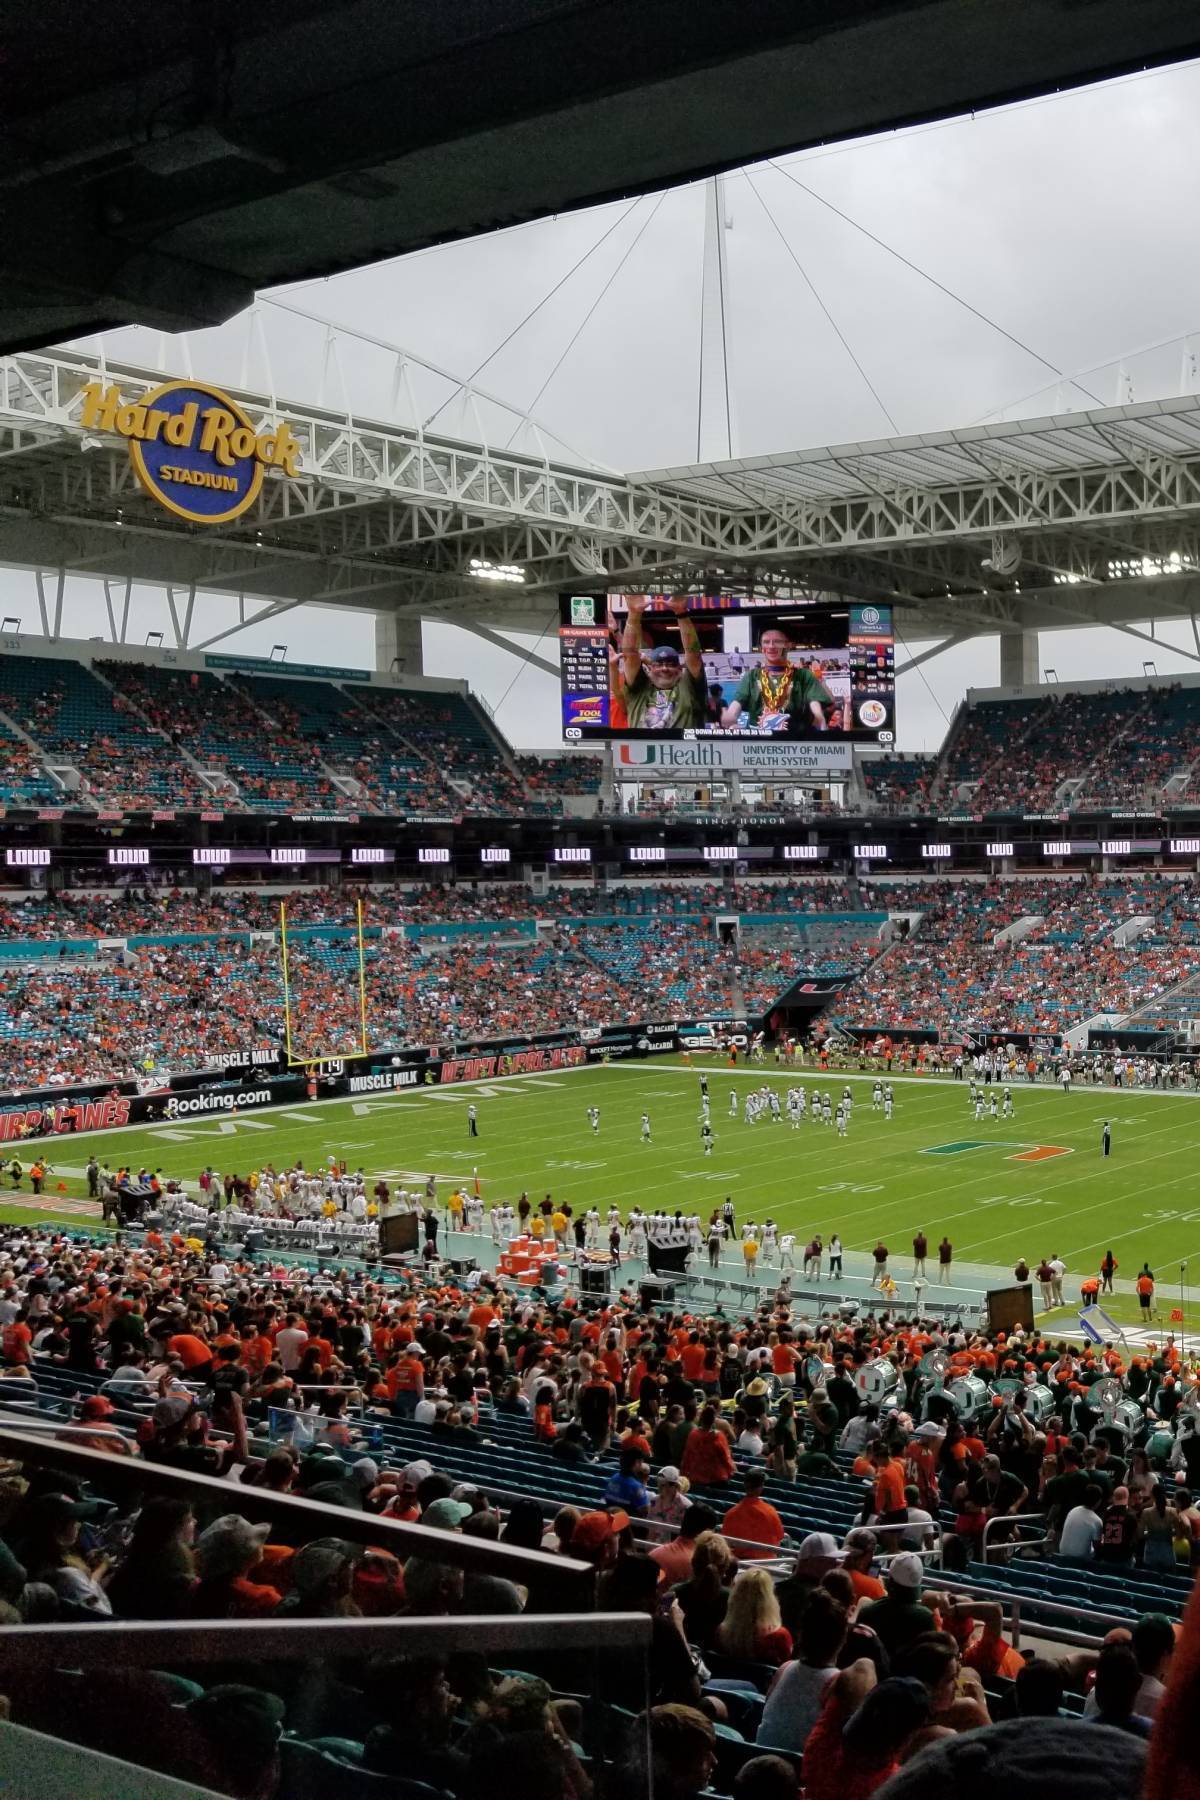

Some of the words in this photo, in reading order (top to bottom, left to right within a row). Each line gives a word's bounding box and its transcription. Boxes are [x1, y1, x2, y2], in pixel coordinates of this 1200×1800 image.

[80, 383, 199, 447] Hard
[200, 407, 300, 478] Rock
[160, 465, 238, 492] STADIUM
[743, 746, 797, 755] UNIVERSITY
[800, 746, 812, 755] OF
[815, 746, 845, 755] MIAMI
[743, 757, 778, 766] HEALTH
[781, 757, 818, 766] SYSTEM
[740, 817, 785, 825] HONOR
[855, 846, 887, 857] LOUD
[923, 844, 950, 856] LOUD
[986, 843, 1013, 855] LOUD
[1043, 843, 1071, 855] LOUD
[1103, 842, 1131, 853] LOUD
[1171, 840, 1200, 852] LOUD
[7, 849, 50, 864] LOUD
[109, 849, 149, 864] LOUD
[194, 849, 230, 863] LOUD
[272, 849, 306, 862] LOUD
[353, 849, 384, 862] LOUD
[419, 849, 449, 861] LOUD
[481, 849, 510, 861] LOUD
[555, 849, 591, 860] LOUD
[631, 848, 664, 860] LOUD
[704, 847, 738, 859] LOUD
[785, 847, 817, 858] LOUD
[205, 1053, 250, 1068] MUSCLE
[252, 1050, 280, 1065] MILK
[328, 1060, 341, 1073] 14
[350, 1074, 391, 1092] MUSCLE
[394, 1071, 418, 1087] MILK
[168, 1089, 271, 1114] Booking.com
[817, 1182, 885, 1193] 50
